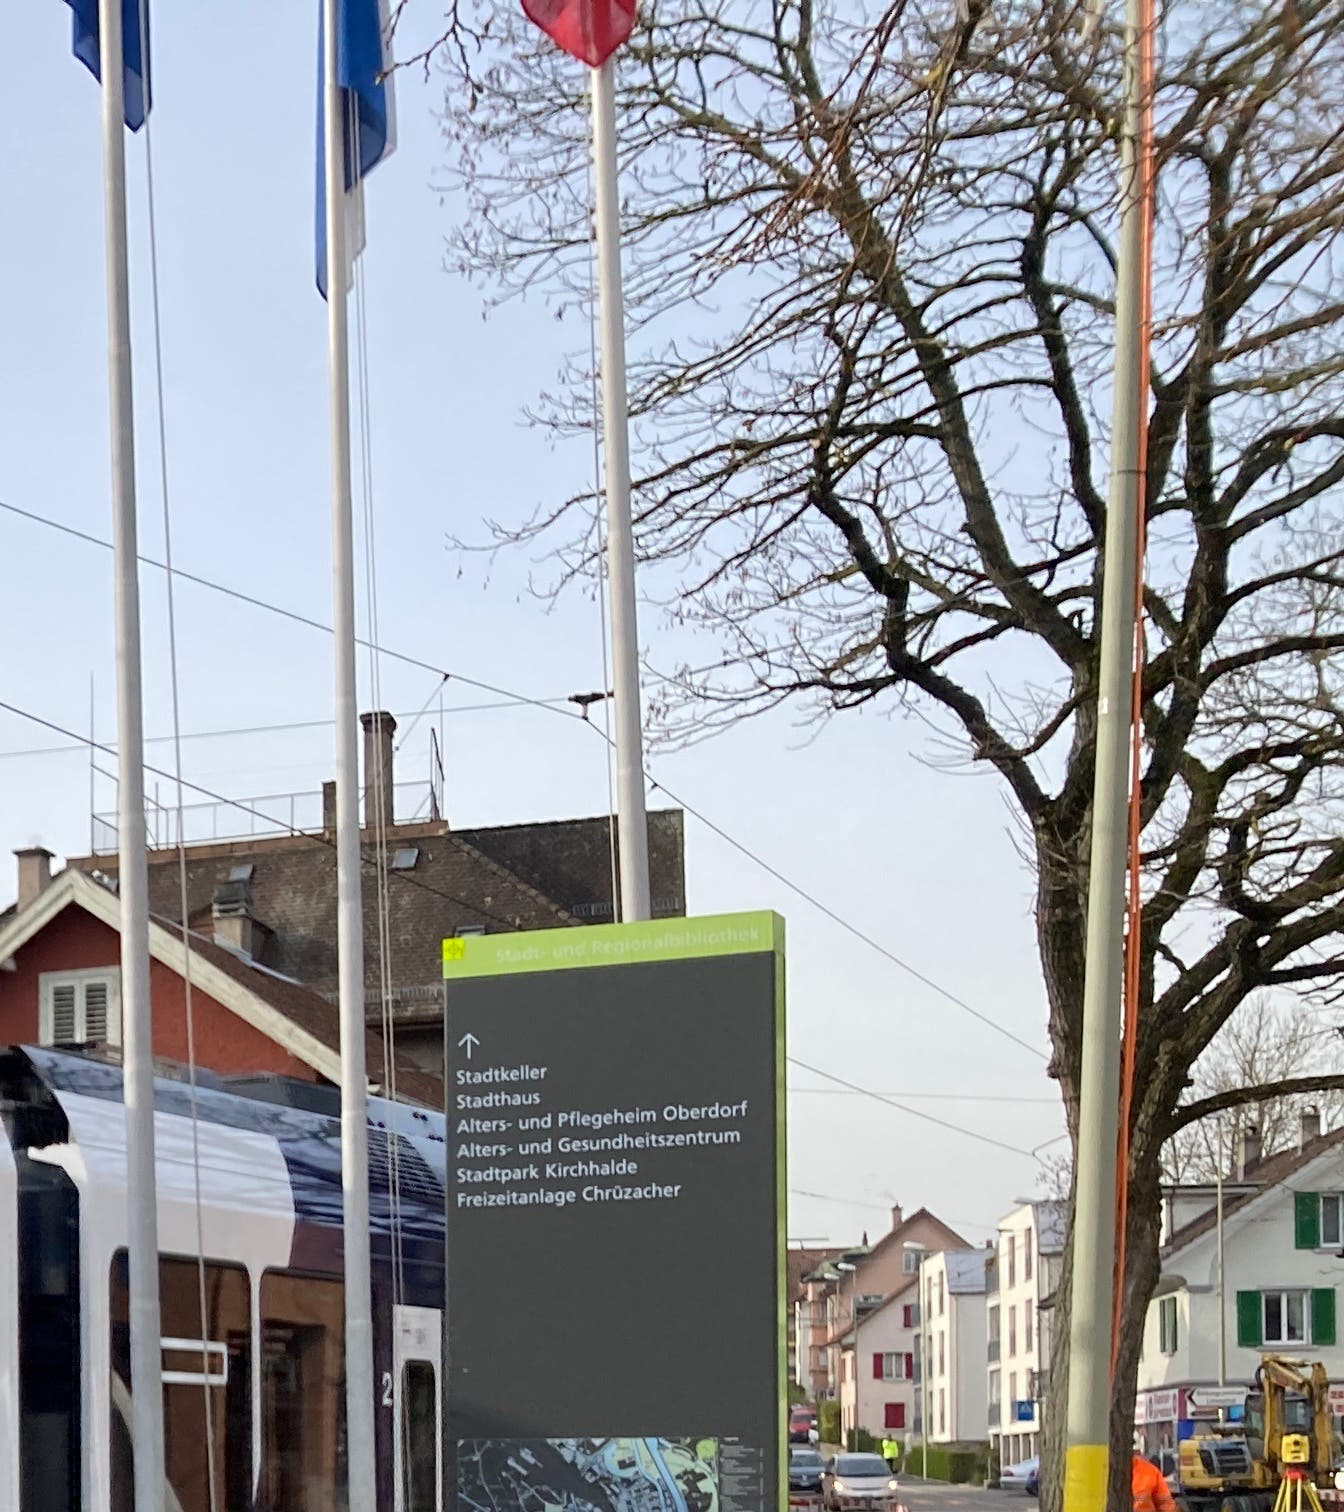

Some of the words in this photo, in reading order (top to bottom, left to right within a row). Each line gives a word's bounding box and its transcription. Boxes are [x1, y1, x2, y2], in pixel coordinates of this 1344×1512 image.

[496, 946, 546, 963] Stadt-
[553, 945, 585, 960] und
[592, 926, 760, 955] Regionalbibliothek
[456, 1064, 547, 1085] Stadtkeller
[456, 1091, 541, 1109] Stadthaus
[456, 1117, 513, 1134] Alters-
[518, 1113, 552, 1130] und
[558, 1107, 657, 1129] Pflegeheim
[663, 1100, 748, 1121] Oberdorf
[456, 1141, 513, 1159] Alters-
[518, 1137, 552, 1155] und
[558, 1130, 741, 1153] Gesundheitszentrum
[456, 1163, 539, 1184] Stadtpark
[546, 1158, 638, 1179] Kirchhalde
[457, 1187, 577, 1208] Freizeitanlage
[582, 1182, 681, 1202] Chrüzacher
[381, 1371, 392, 1406] 2
